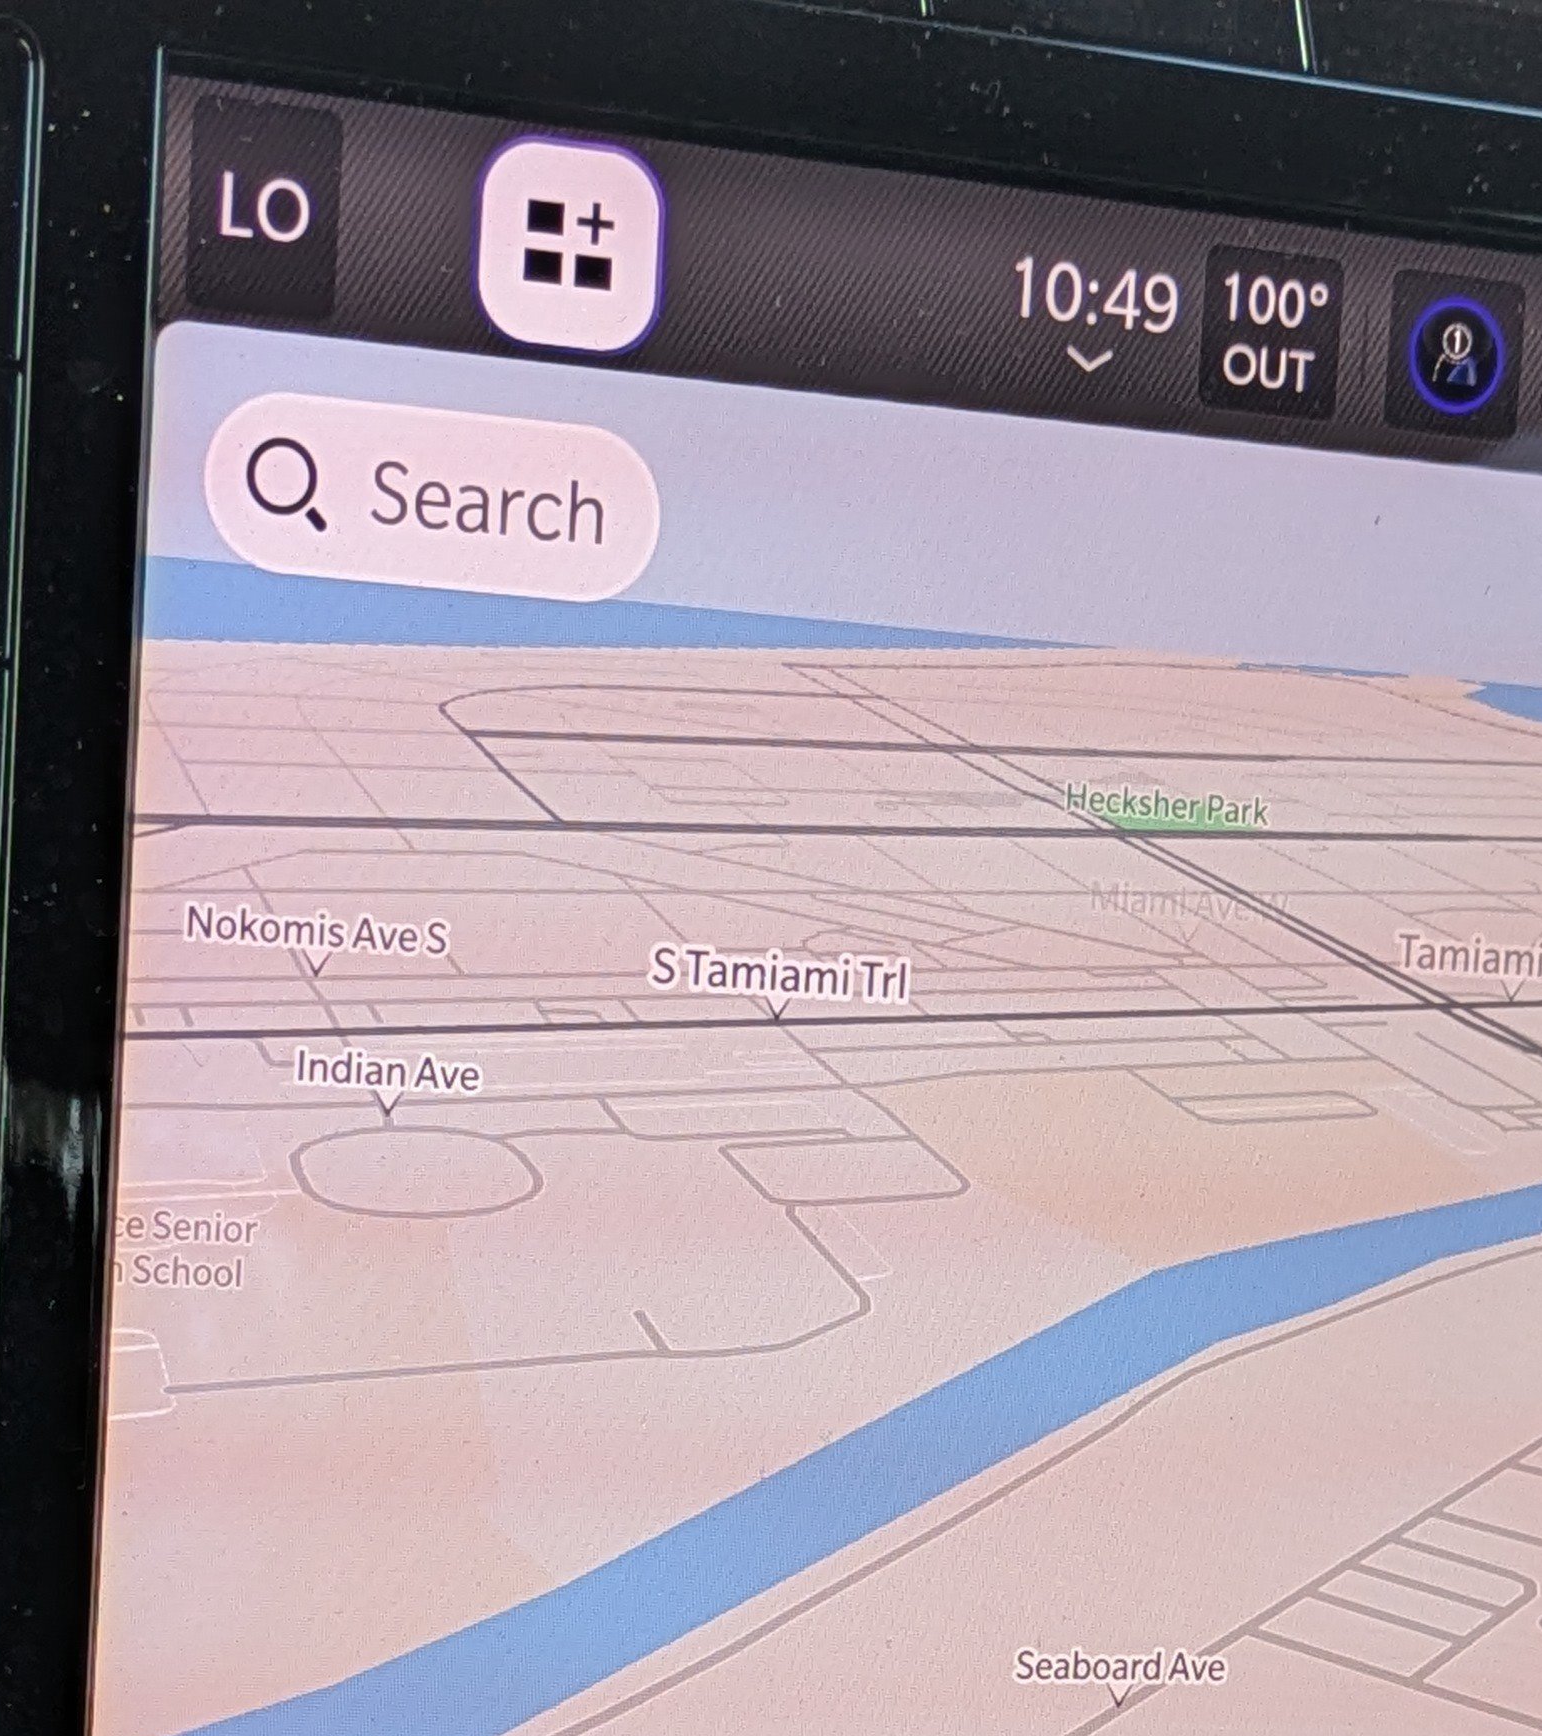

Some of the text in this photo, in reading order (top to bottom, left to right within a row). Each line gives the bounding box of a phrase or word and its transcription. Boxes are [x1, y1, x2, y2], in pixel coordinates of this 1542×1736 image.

[218, 170, 311, 243] LO
[1013, 255, 1180, 334] 10:49
[1221, 343, 1316, 394] OUT
[371, 460, 606, 545] Search
[1066, 783, 1269, 827] Hecksher Park
[185, 905, 448, 956] Nokomis Ave S
[652, 948, 908, 1002] S Tamiami Trl
[294, 1050, 481, 1093] Indian Ave
[152, 1211, 258, 1244] Senior
[132, 1254, 242, 1288] School
[1015, 1650, 1226, 1684] Seaboard Ave
